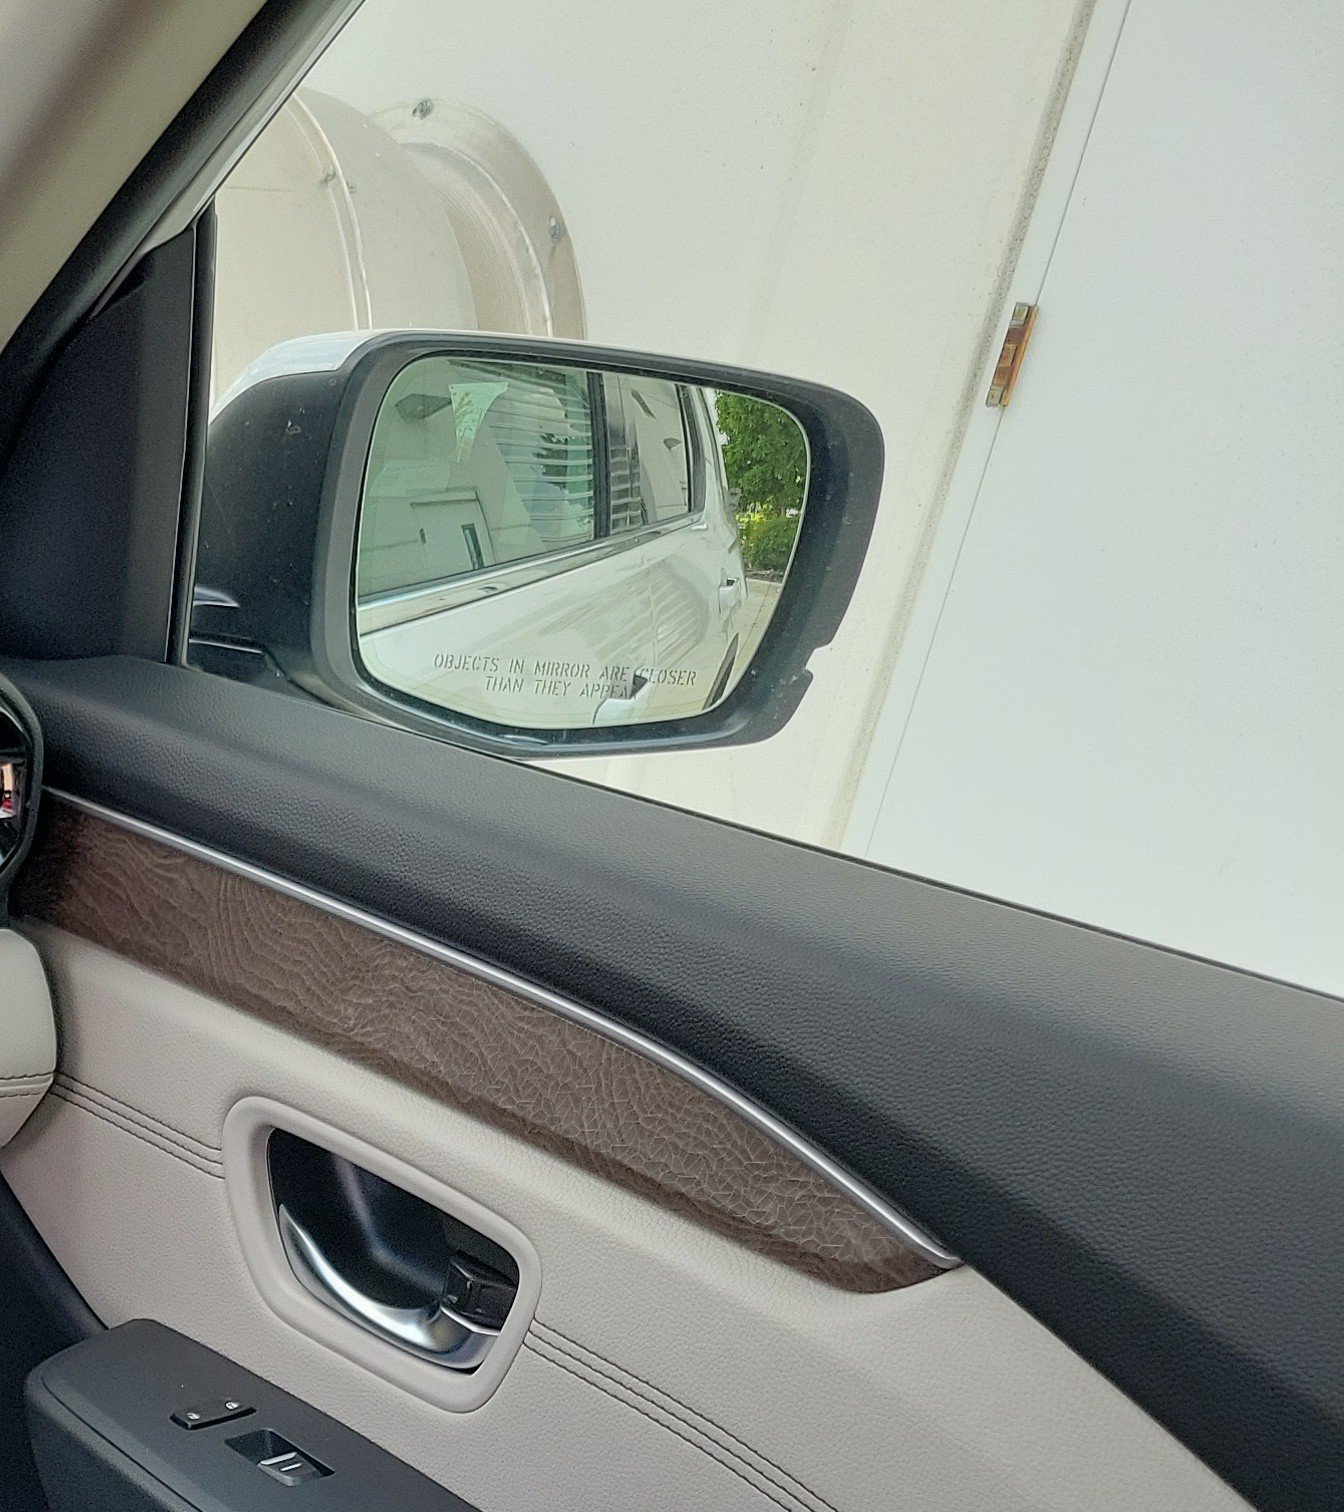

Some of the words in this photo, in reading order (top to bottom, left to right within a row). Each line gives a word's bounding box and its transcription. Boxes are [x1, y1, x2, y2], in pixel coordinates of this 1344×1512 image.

[433, 653, 500, 673] OBJECTS
[509, 658, 525, 674] IN
[534, 661, 591, 680] MIRROR
[599, 665, 630, 681] ARE
[639, 668, 697, 686] CLOSER
[485, 675, 523, 694] THAN
[534, 678, 571, 696] THEY
[579, 683, 636, 699] APPEA
